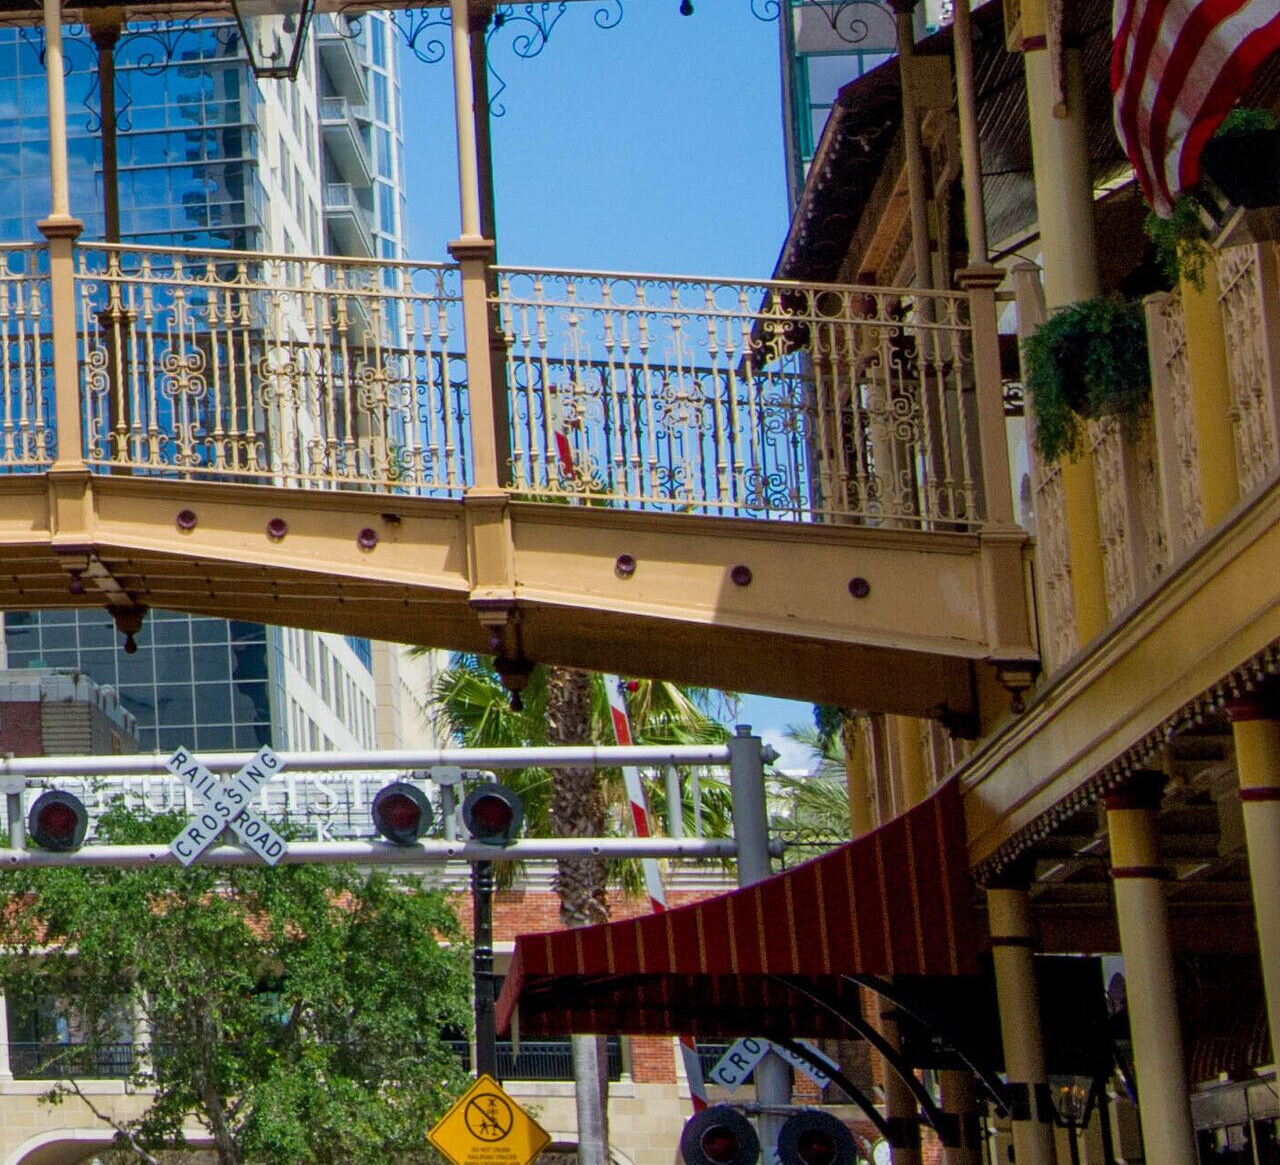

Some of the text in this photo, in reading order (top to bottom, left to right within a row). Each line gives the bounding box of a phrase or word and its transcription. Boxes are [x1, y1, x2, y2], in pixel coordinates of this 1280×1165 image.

[170, 752, 215, 800] RAIL
[233, 810, 282, 857] ROAD
[176, 753, 277, 857] CROSSING
